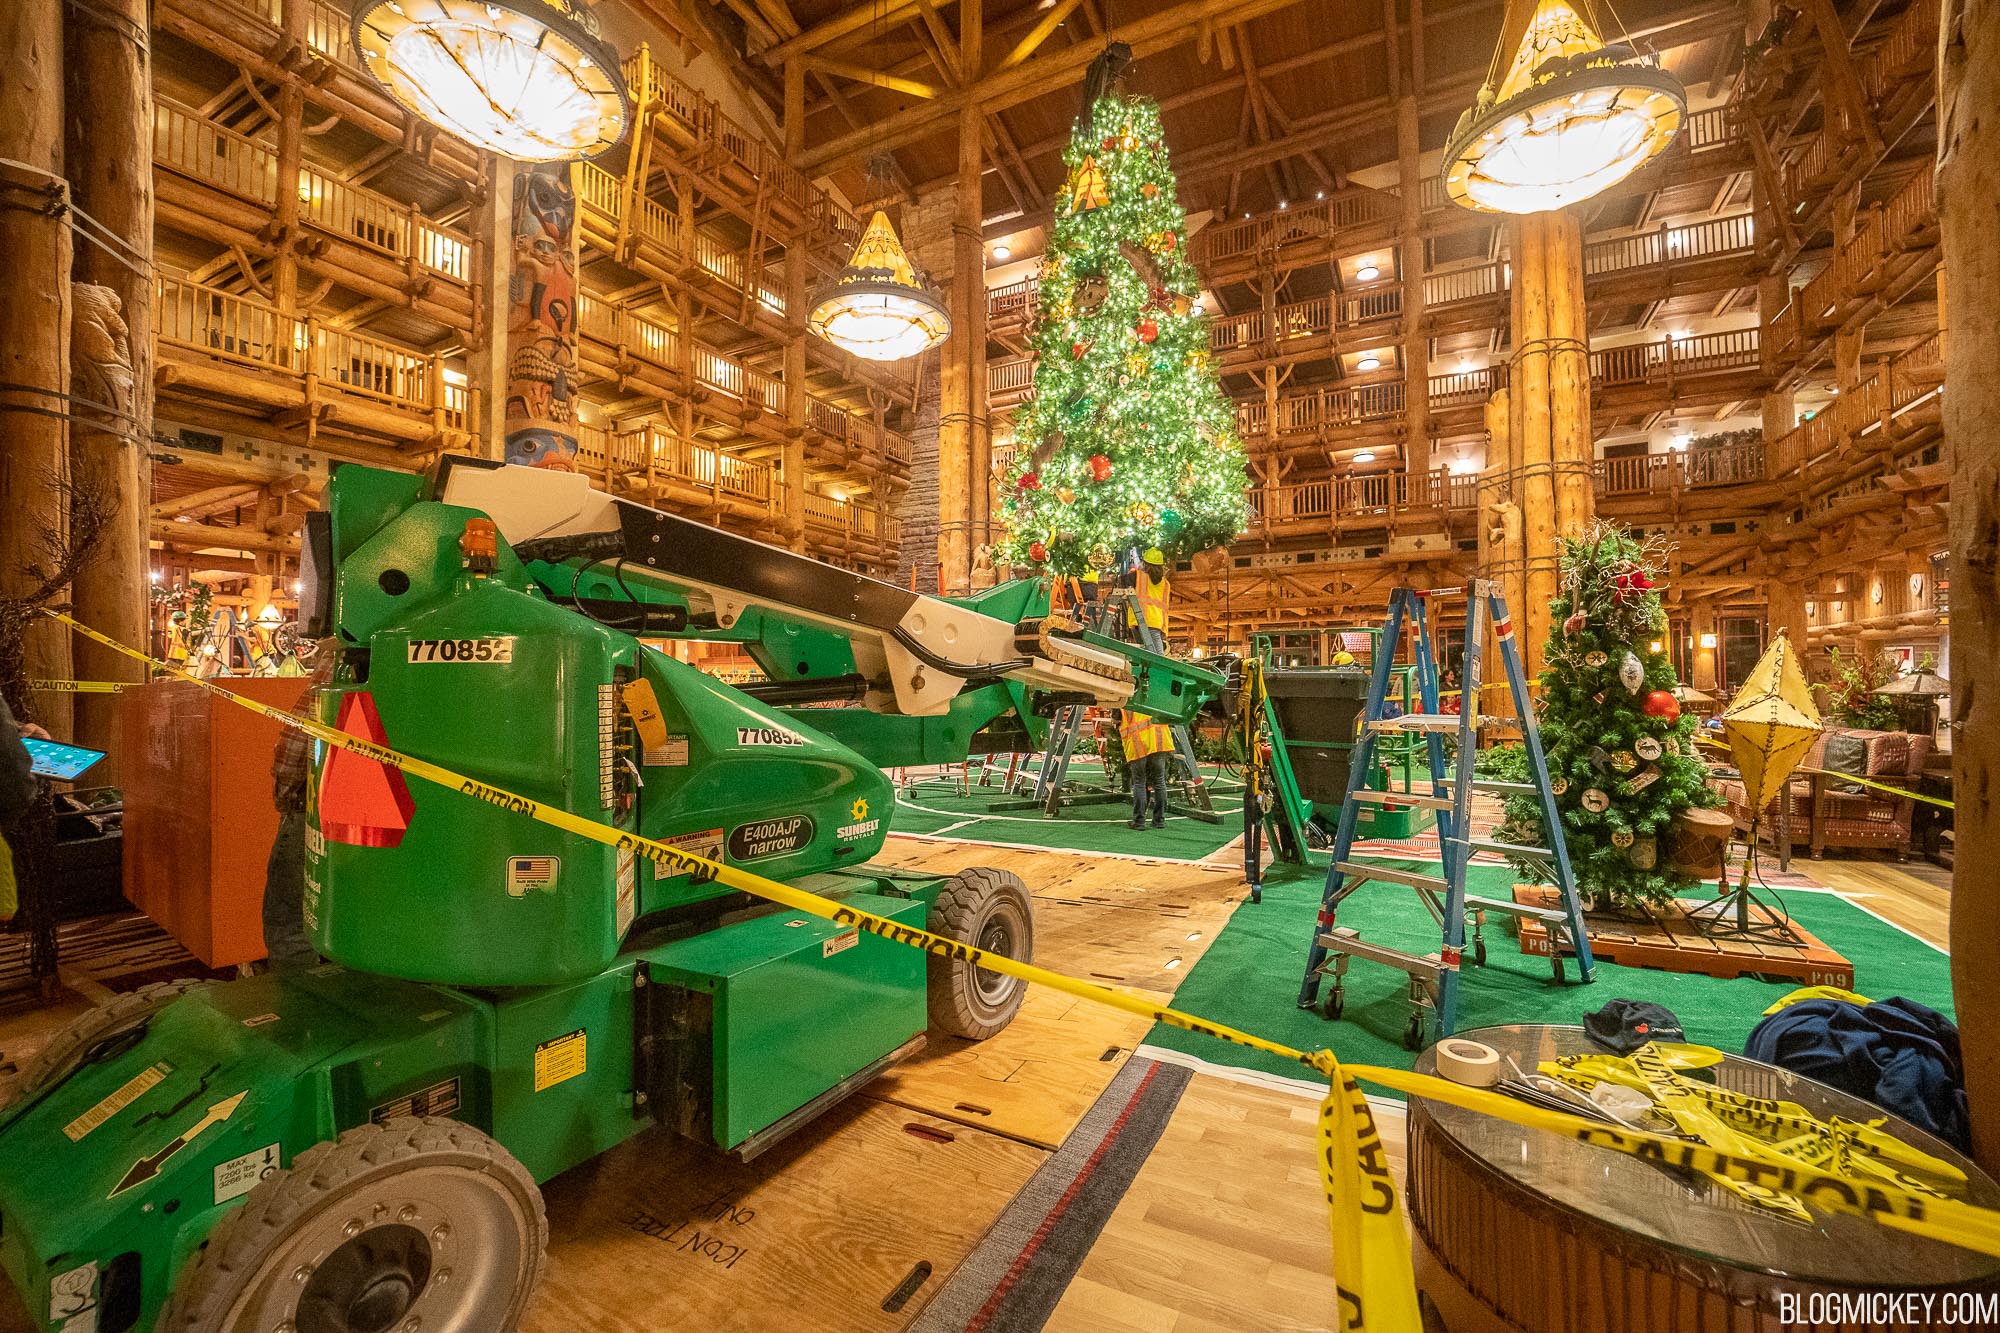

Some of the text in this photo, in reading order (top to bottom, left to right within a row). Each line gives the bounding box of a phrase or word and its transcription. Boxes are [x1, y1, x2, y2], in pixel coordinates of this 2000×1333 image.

[409, 640, 512, 661] 770852
[33, 681, 79, 691] CAUTION
[738, 727, 803, 745] 770852
[676, 831, 711, 843] WARNING
[743, 819, 802, 842] E400AJP
[837, 819, 880, 839] SUNBELT
[843, 831, 875, 842] RENTALS
[748, 836, 797, 856] narrow
[1812, 971, 1847, 987] P09
[547, 1033, 575, 1047] IMPORTANT
[226, 1157, 247, 1171] MAX
[243, 1163, 257, 1172] lbs
[243, 1171, 255, 1179] kg
[688, 1187, 756, 1227] ONLY
[622, 1210, 749, 1269] ICON TREE
